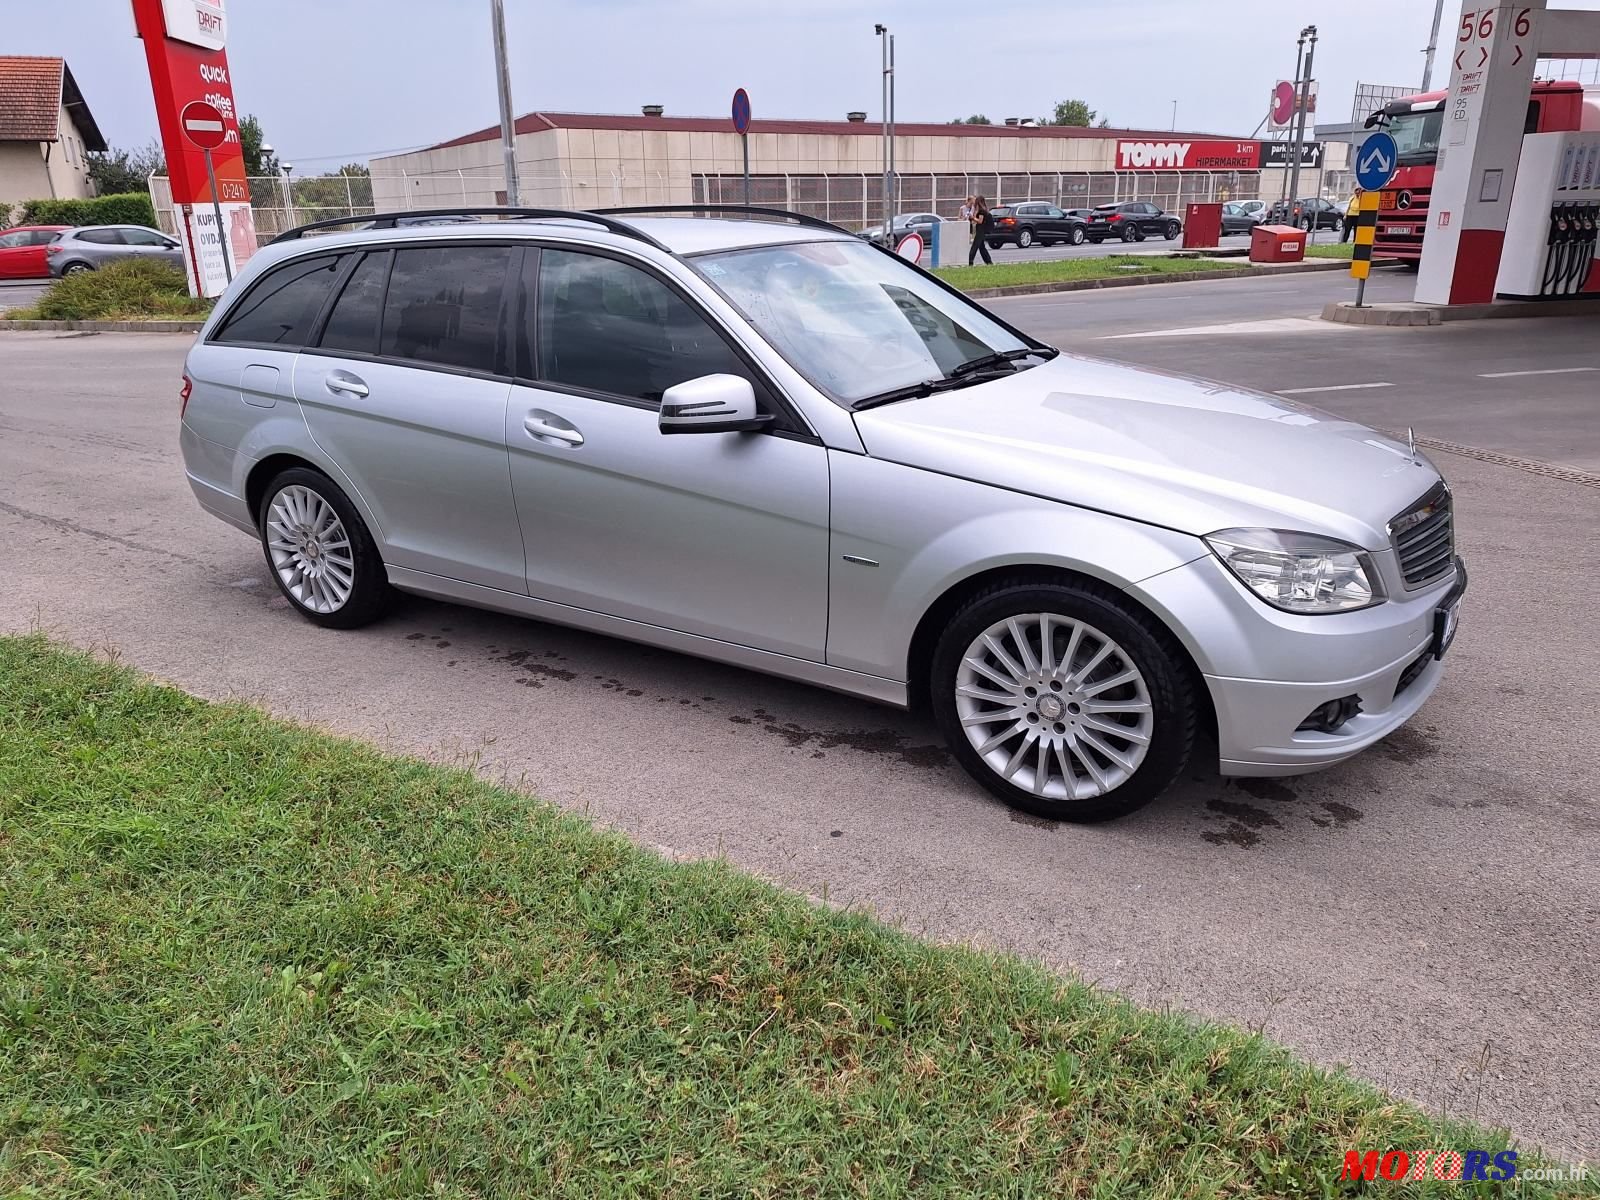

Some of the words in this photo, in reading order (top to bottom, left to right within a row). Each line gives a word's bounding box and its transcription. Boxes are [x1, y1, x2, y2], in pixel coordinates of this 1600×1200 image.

[196, 9, 222, 32] DRIFT
[1459, 12, 1475, 42] 5
[1478, 9, 1494, 39] 6
[1515, 8, 1531, 37] 6
[200, 63, 228, 83] quick
[1462, 71, 1483, 81] DRIFT
[1460, 84, 1481, 93] DRIFT
[205, 92, 232, 110] coffee
[1456, 98, 1468, 109] 95
[1454, 109, 1466, 120] ED
[1120, 142, 1191, 167] TOMMY
[1236, 143, 1242, 153] 1
[1242, 144, 1254, 153] km
[1271, 144, 1287, 156] park
[1195, 157, 1252, 167] HIPERMARKET
